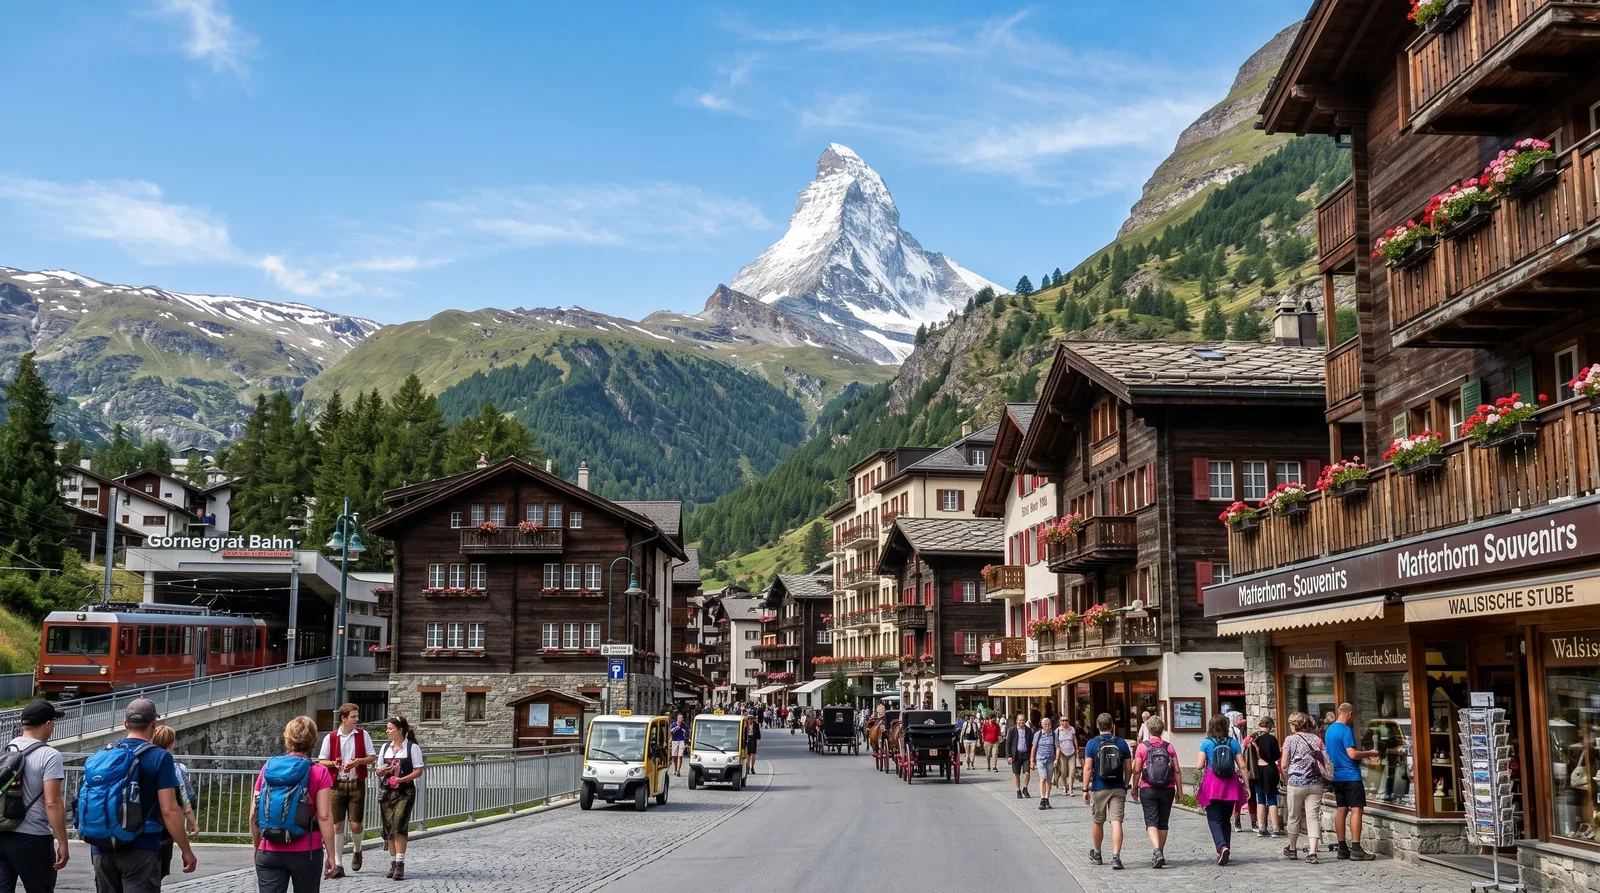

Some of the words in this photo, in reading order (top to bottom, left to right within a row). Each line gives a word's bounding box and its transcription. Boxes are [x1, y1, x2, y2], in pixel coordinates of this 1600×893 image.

[147, 533, 244, 552] Gornergrat
[249, 534, 294, 549] Bahn
[1398, 543, 1479, 579] Matterhorn
[1483, 519, 1578, 564] Souvenirs
[1238, 581, 1287, 607] Matterhorn
[1293, 567, 1348, 598] Souvenirs
[1448, 591, 1523, 615] WALISISCHE
[1527, 585, 1575, 607] STUBE
[1384, 648, 1407, 665] Stube
[1551, 636, 1600, 659] Walsis
